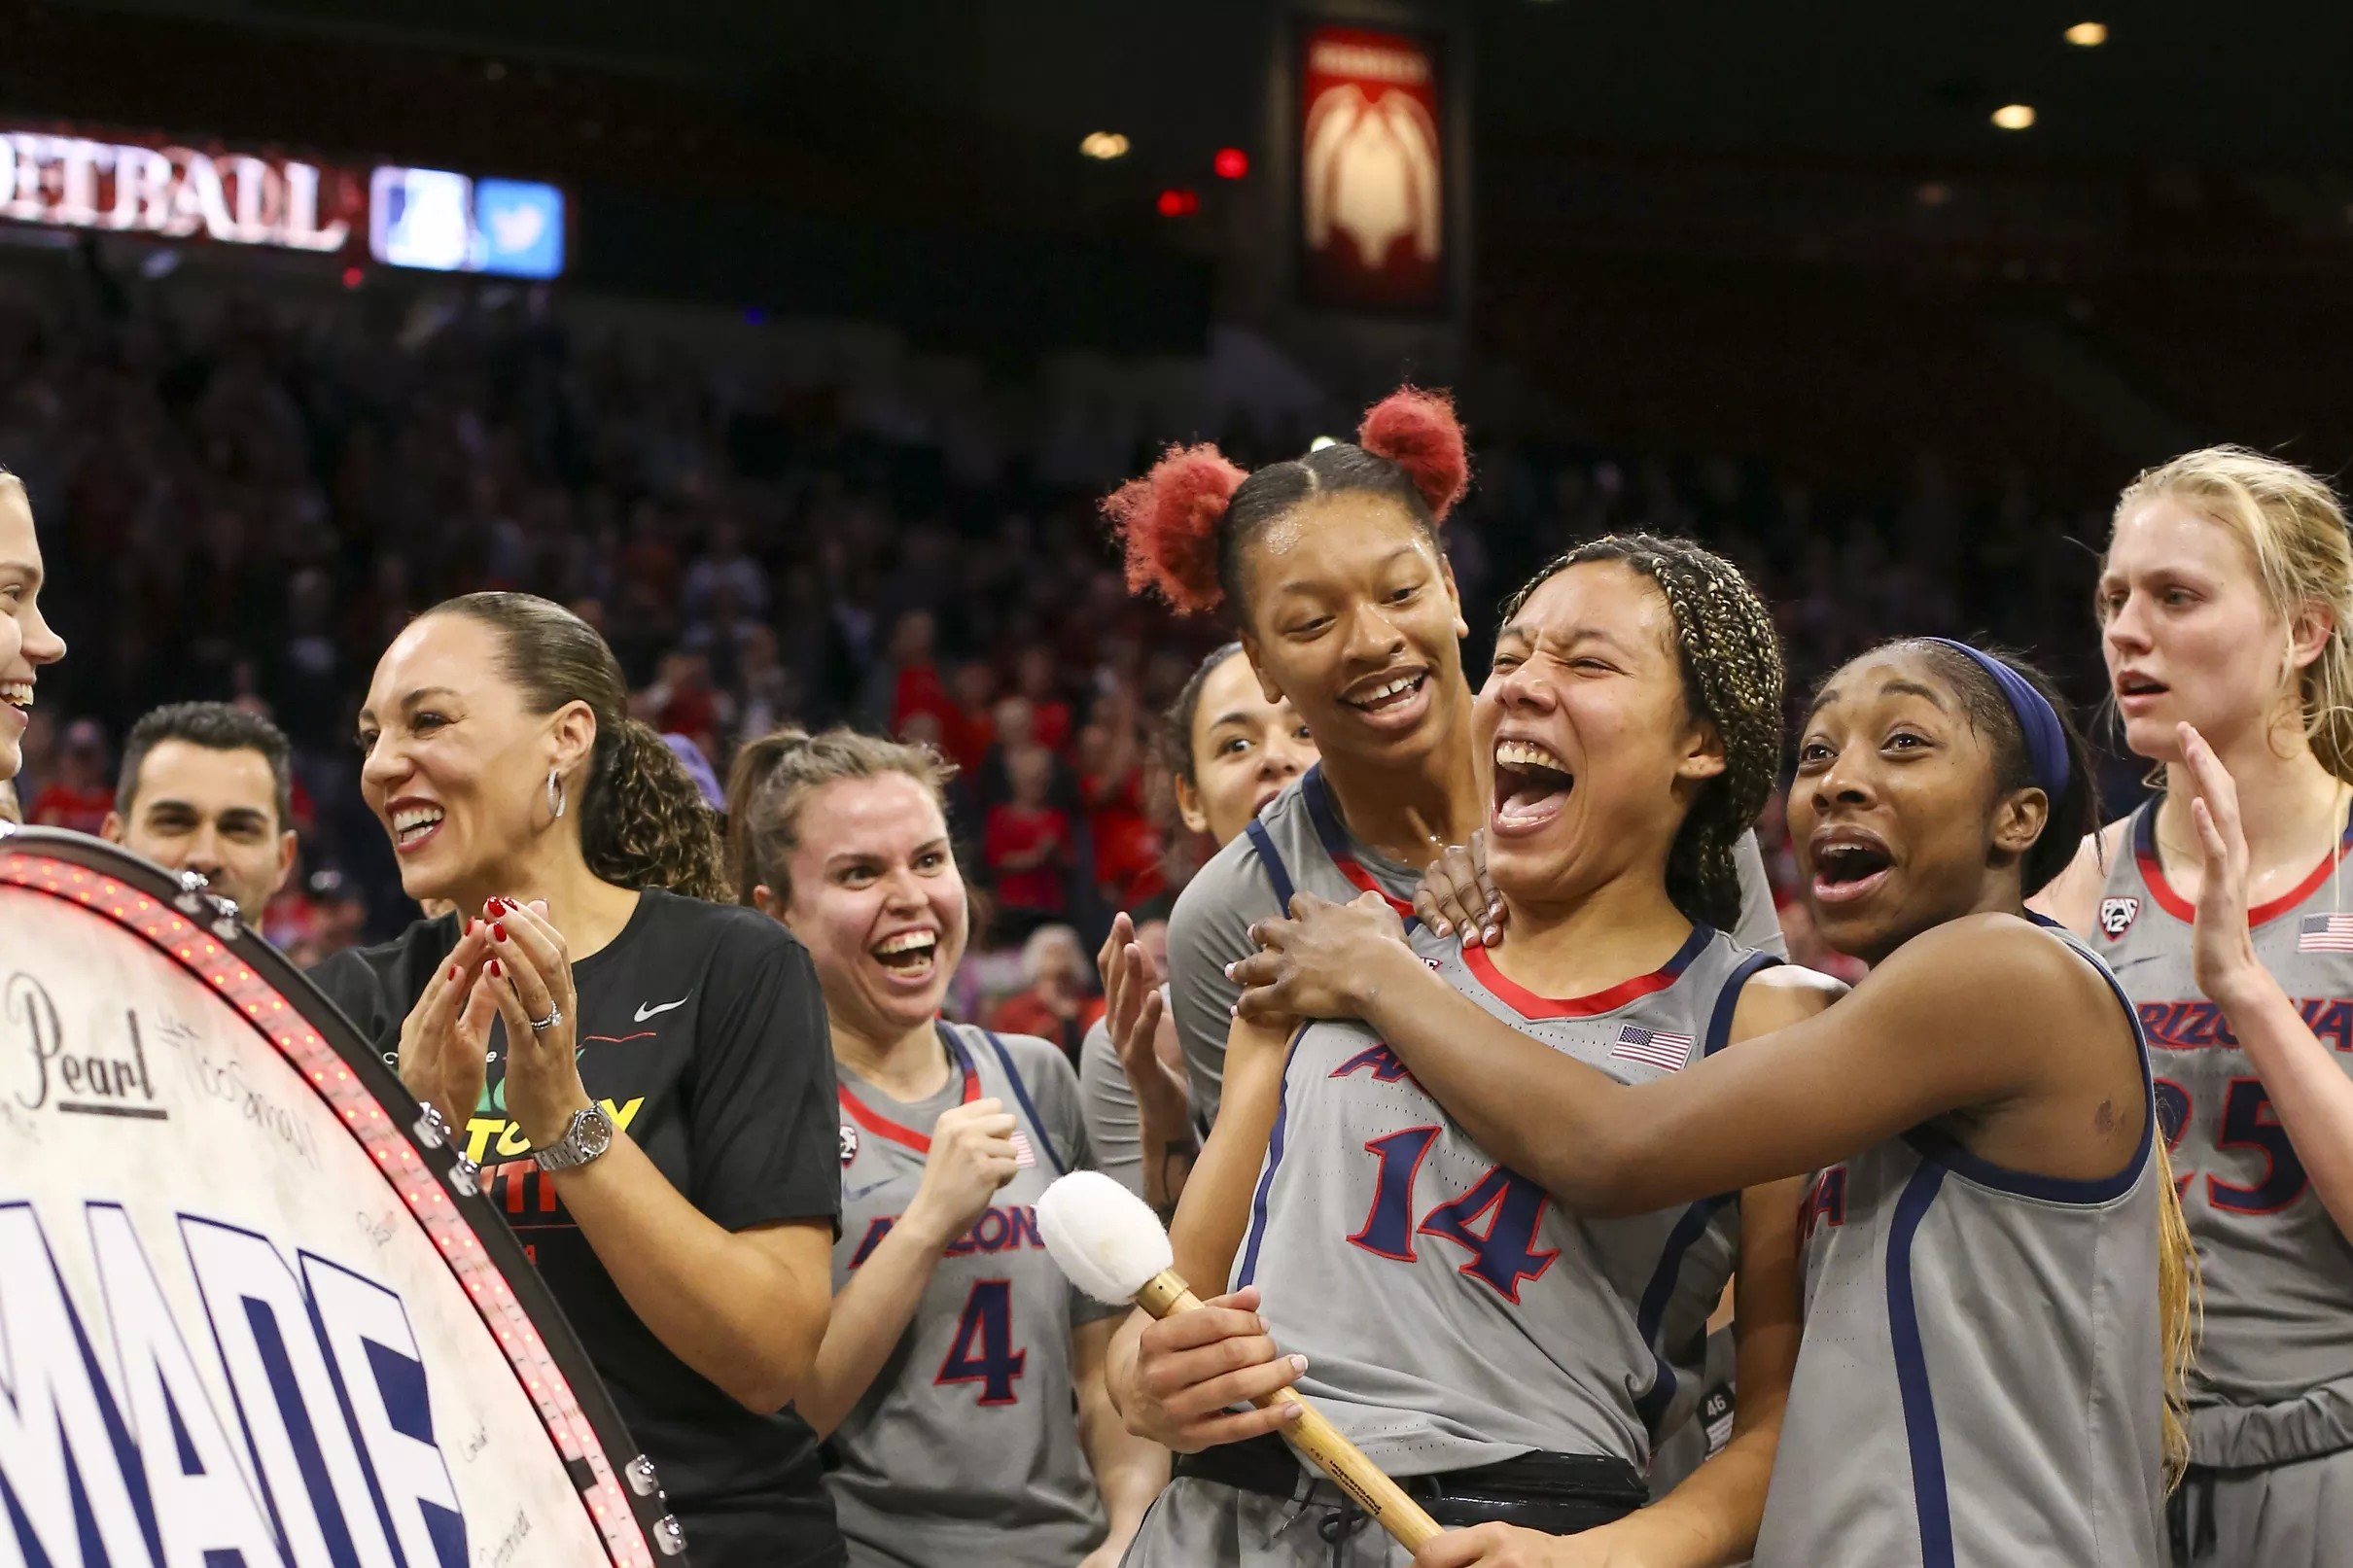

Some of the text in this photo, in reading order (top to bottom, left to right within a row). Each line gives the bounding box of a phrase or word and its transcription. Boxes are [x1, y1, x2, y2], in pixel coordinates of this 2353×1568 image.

[5, 971, 155, 1110] Pearl
[1346, 1125, 1563, 1306] 14
[932, 1278, 1028, 1407] 4
[1706, 1393, 1727, 1417] 46
